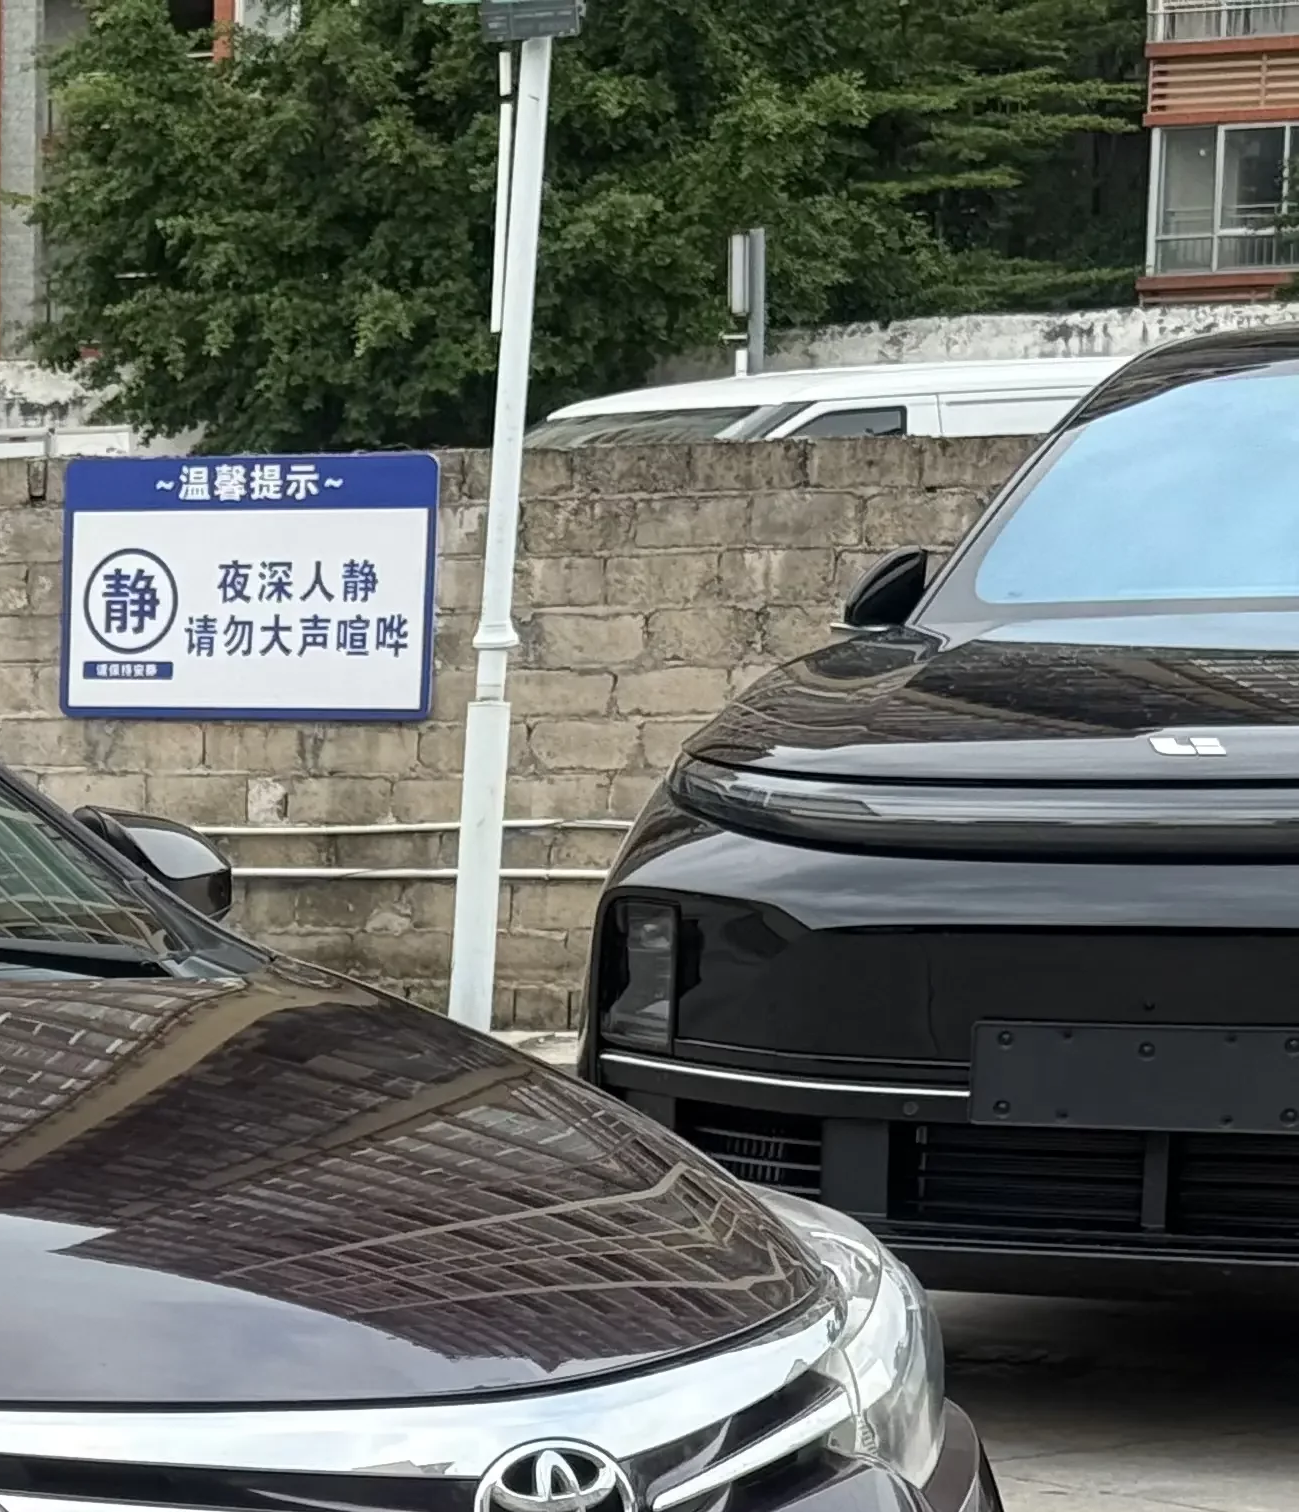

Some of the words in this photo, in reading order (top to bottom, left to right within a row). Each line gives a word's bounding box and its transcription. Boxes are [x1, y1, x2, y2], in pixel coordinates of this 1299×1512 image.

[101, 567, 161, 635] 静
[217, 559, 379, 604] 夜深人静
[184, 613, 409, 658] 请勿大声喧哗
